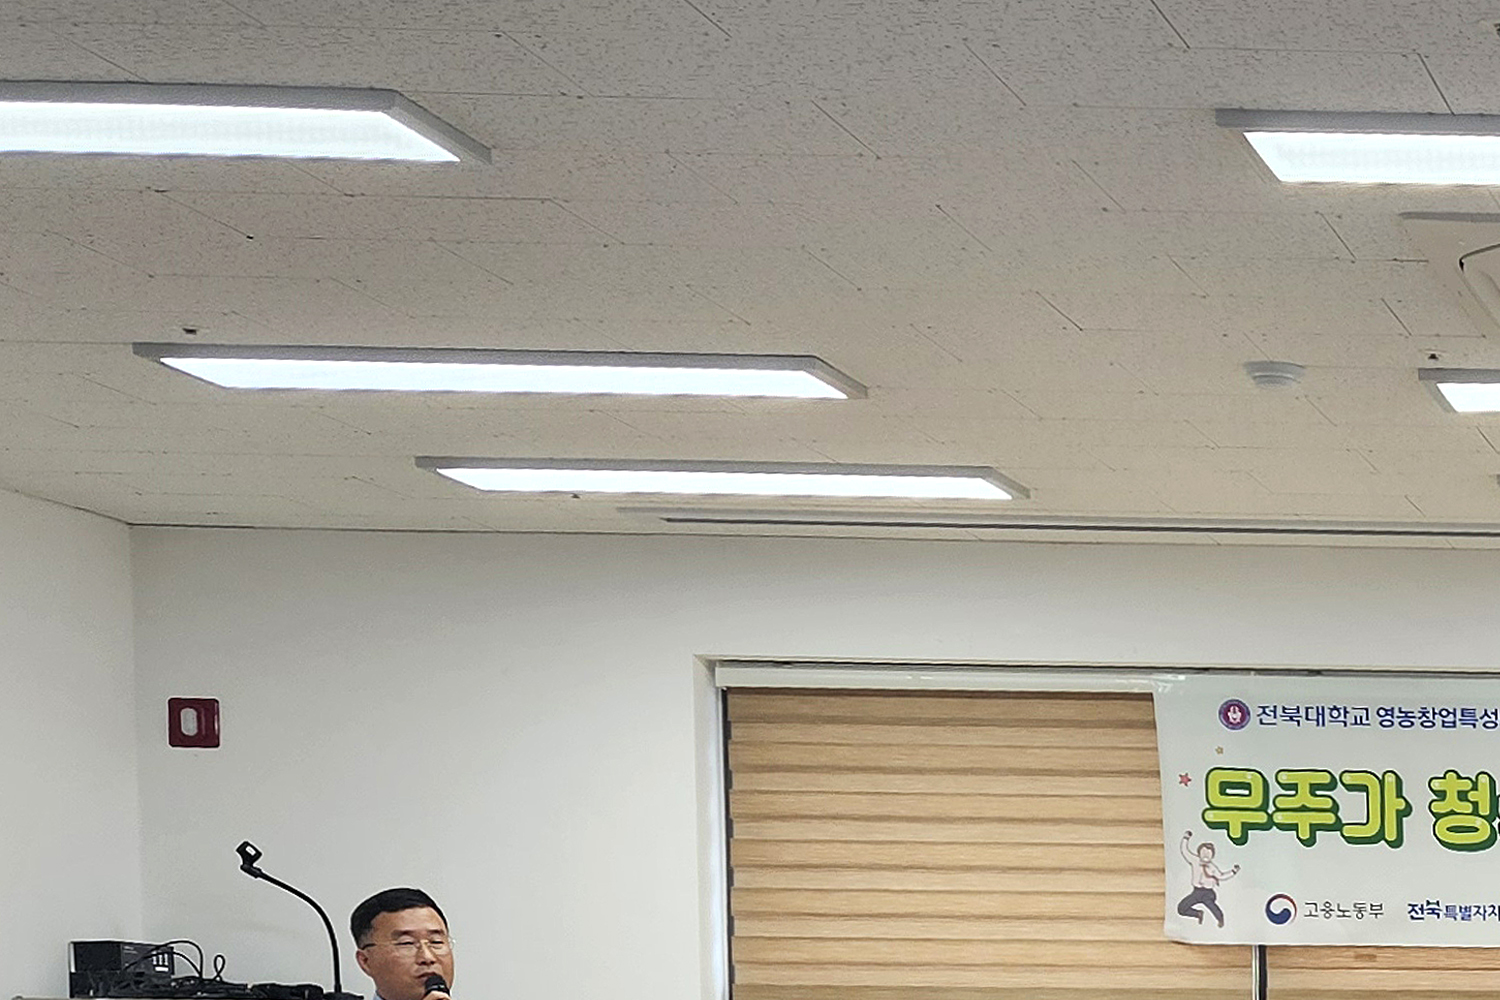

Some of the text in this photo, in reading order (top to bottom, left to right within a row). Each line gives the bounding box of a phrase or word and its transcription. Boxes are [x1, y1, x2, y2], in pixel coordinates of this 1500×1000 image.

[1257, 705, 1371, 727] 전북대학교
[1202, 767, 1412, 848] 무주가
[1303, 901, 1384, 920] 고용노동부
